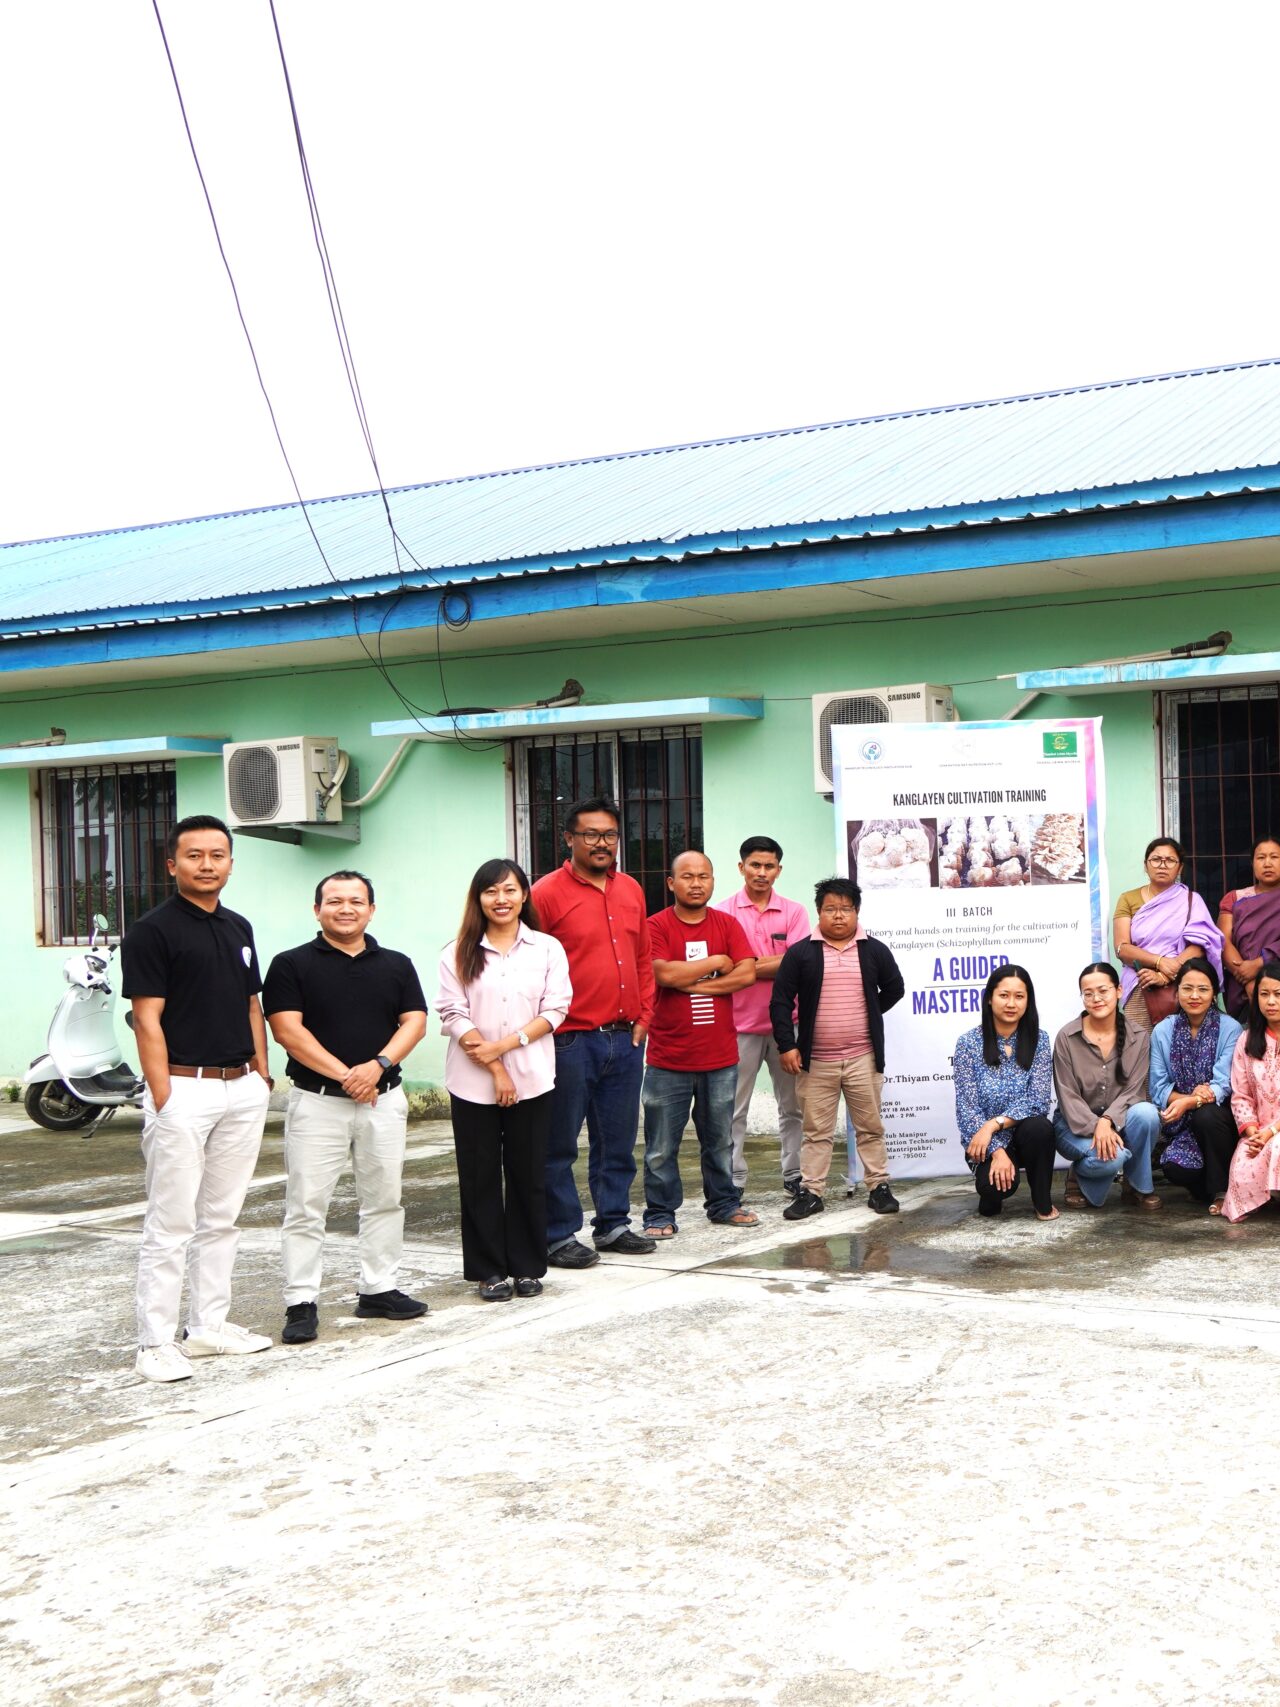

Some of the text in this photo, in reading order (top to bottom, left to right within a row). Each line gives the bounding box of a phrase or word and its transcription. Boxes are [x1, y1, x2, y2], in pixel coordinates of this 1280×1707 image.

[888, 692, 921, 701] SAMSUNG
[893, 789, 1047, 806] KANGLAYEN CULTIVATION TRAINING
[946, 906, 993, 918] III BATCH
[896, 927, 912, 935] and
[914, 926, 940, 935] hands
[956, 924, 991, 934] training
[992, 923, 1005, 934] for
[1007, 923, 1021, 932] the
[1023, 921, 1068, 931] cultivation
[1070, 920, 1079, 930] of
[890, 941, 934, 951] Kanglayen
[936, 937, 1002, 949] (Schizophyllum
[933, 957, 944, 981] A
[912, 988, 986, 1015] MASTER
[909, 1137, 947, 1145] Technology
